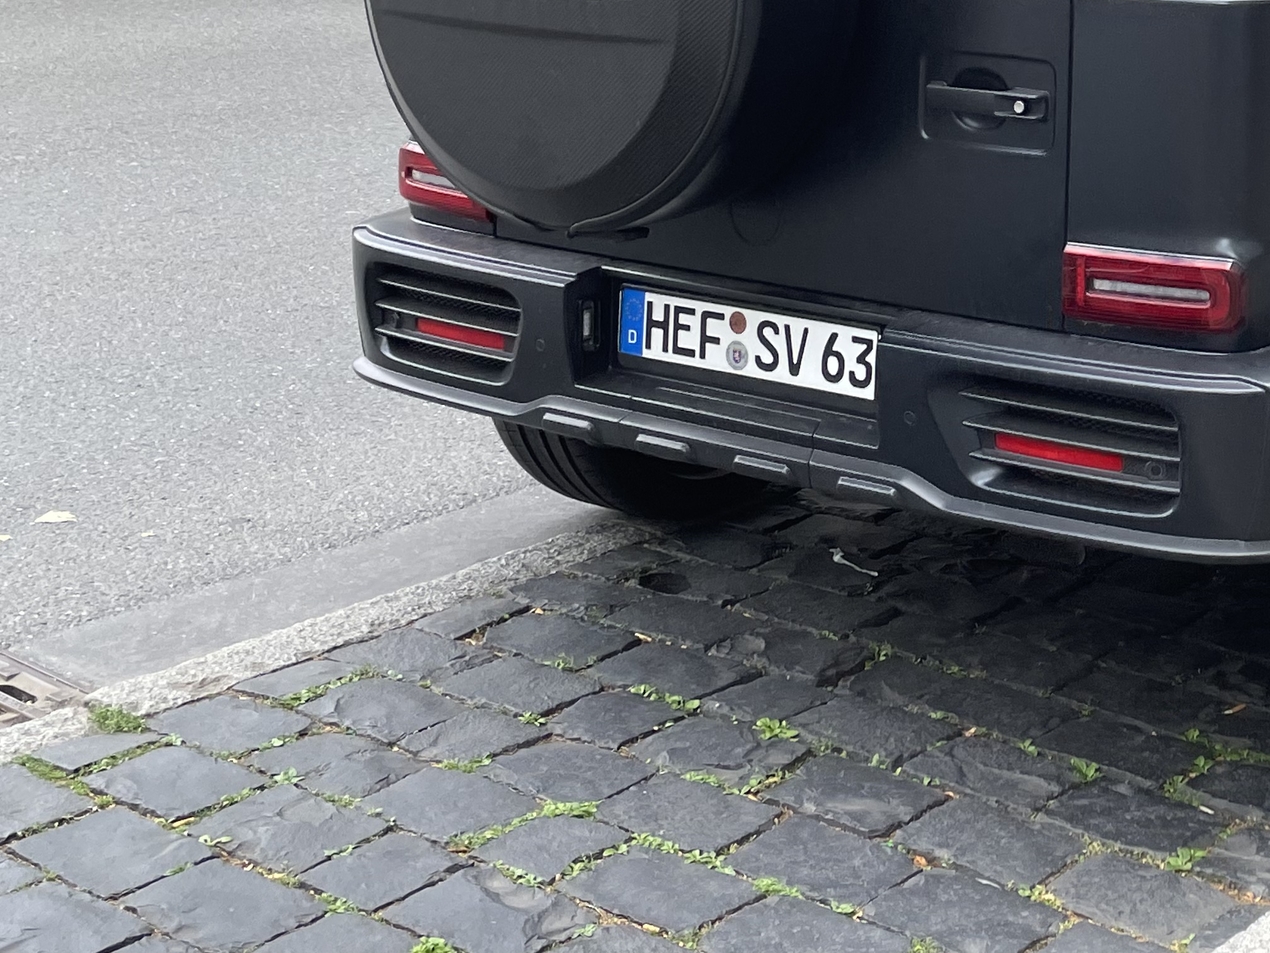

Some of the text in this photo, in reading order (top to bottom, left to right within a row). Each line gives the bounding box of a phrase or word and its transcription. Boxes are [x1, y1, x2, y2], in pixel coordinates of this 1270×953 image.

[628, 301, 875, 389] D HEF SV 63
